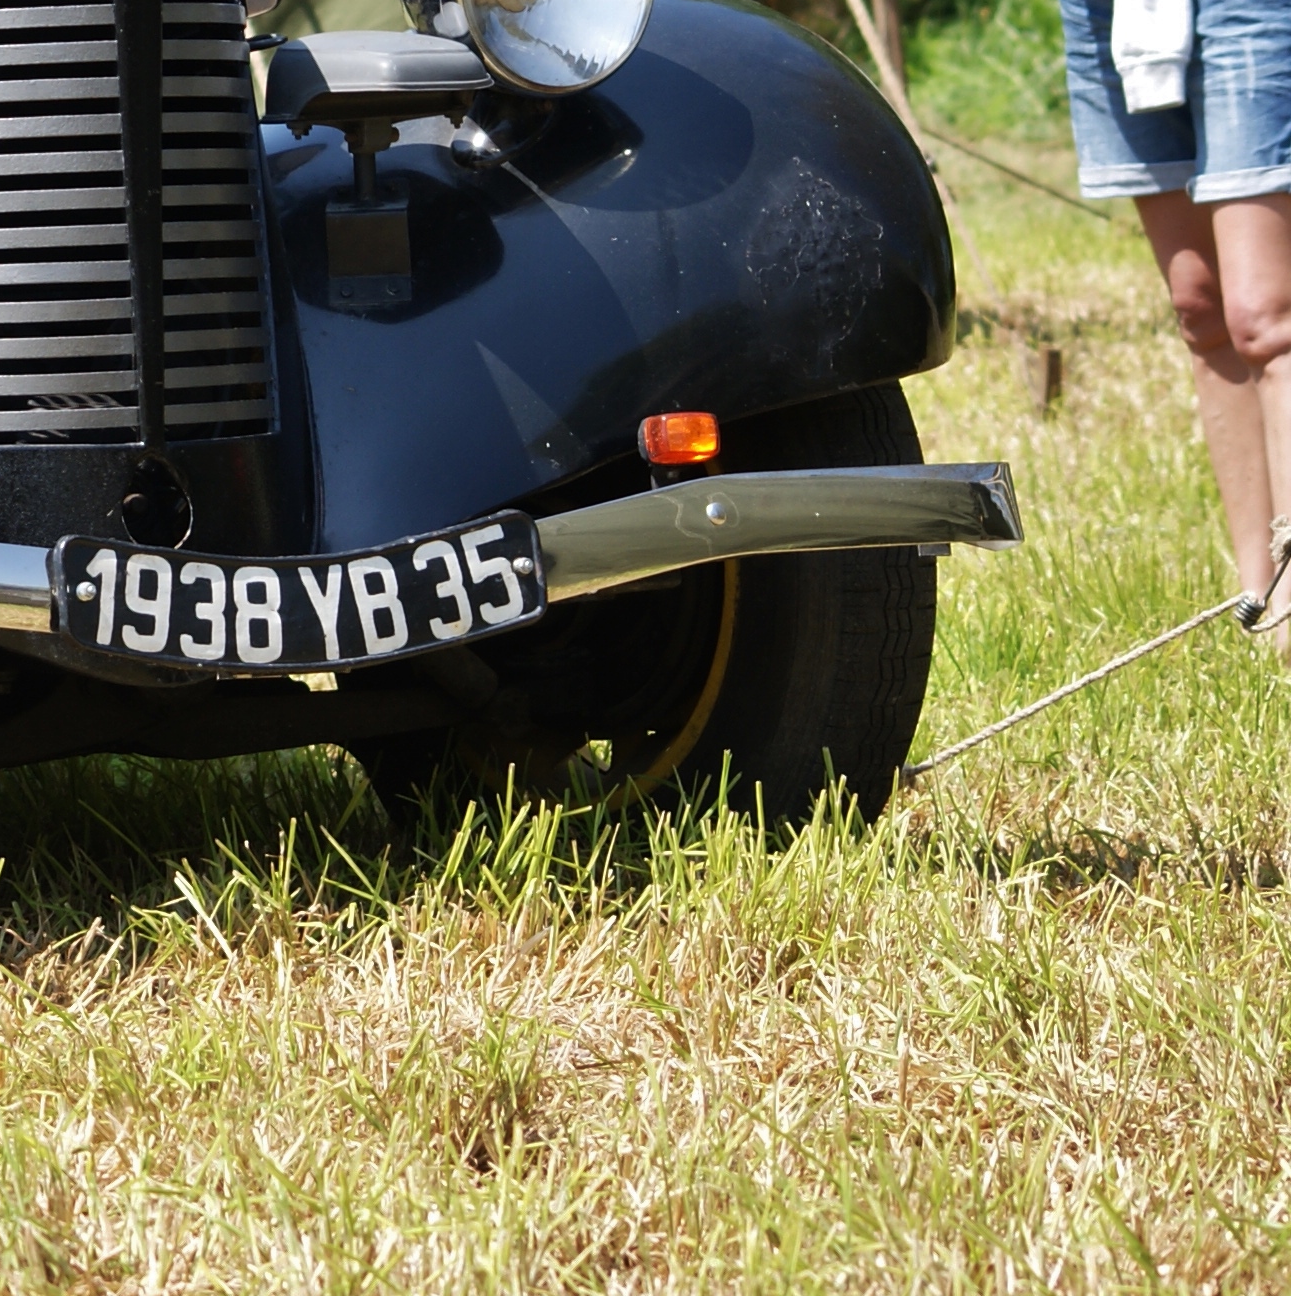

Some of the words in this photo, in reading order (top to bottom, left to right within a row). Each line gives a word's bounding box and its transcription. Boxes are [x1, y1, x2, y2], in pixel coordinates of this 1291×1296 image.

[85, 547, 284, 664] 1938
[298, 556, 409, 661] YB
[412, 523, 525, 641] 35
